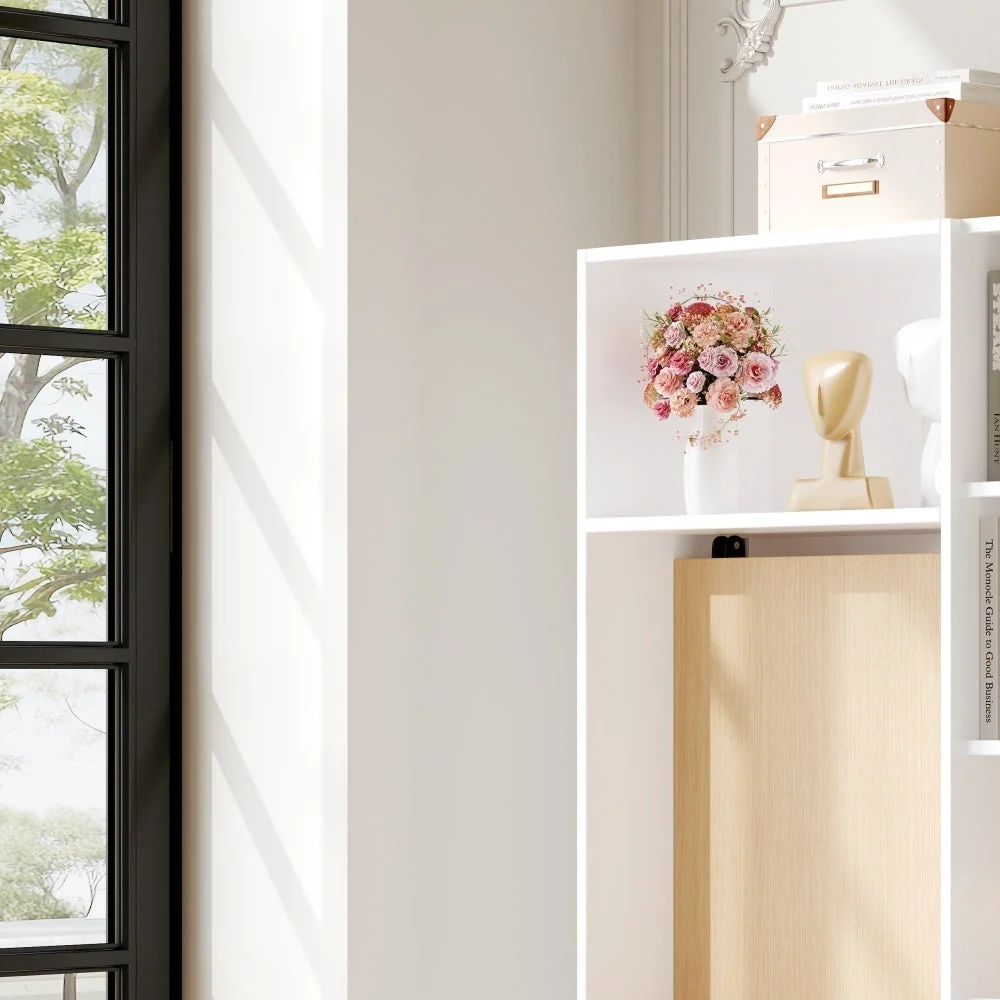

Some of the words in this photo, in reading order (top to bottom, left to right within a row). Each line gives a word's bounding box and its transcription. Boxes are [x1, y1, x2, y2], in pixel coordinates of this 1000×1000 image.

[985, 539, 993, 558] The
[985, 562, 993, 604] Monocle
[985, 607, 993, 635] Guide
[985, 640, 992, 648] to
[985, 651, 993, 678] Good
[985, 682, 993, 722] Business
